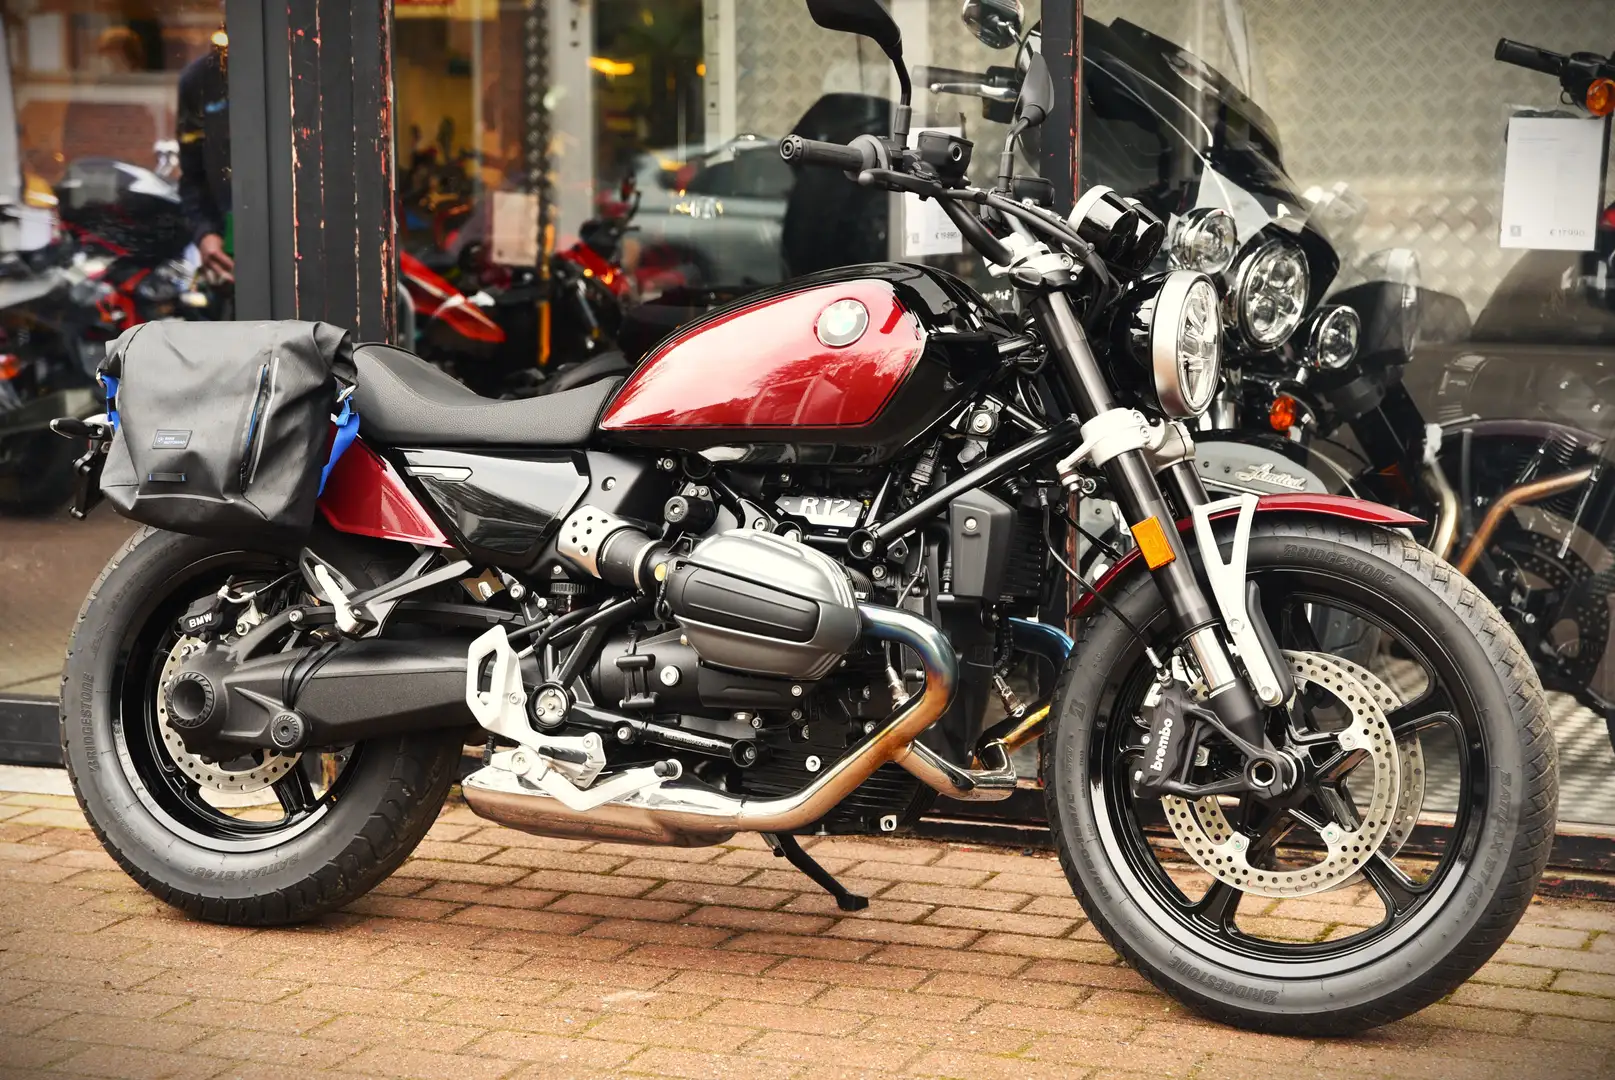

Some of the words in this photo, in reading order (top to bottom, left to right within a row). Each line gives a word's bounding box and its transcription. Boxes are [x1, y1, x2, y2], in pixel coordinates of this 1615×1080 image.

[1234, 462, 1308, 491] Limited
[1283, 543, 1397, 585] BRIDGESTONE
[188, 612, 212, 629] BMW
[80, 671, 100, 773] BRIDGESTONE
[1149, 717, 1174, 772] brembo
[1167, 955, 1279, 1006] BRIDGESTONE
